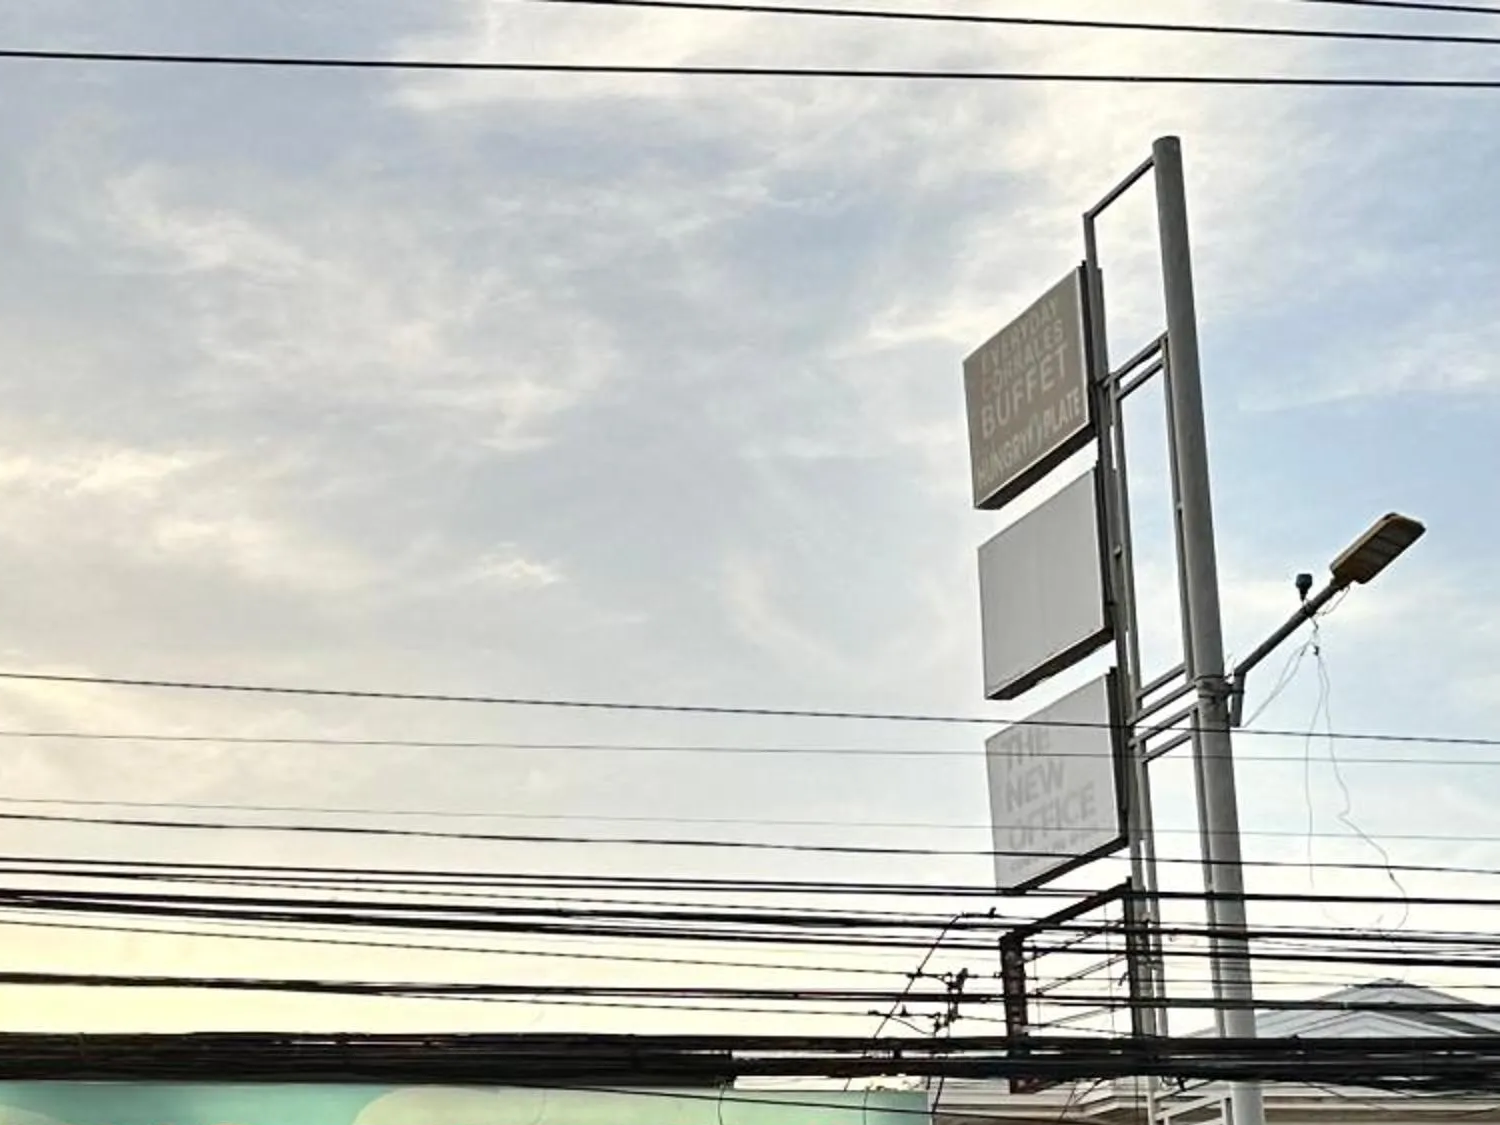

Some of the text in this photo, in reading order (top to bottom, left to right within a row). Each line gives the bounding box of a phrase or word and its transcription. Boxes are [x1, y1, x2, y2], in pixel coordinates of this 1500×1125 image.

[981, 299, 1057, 375] EVERYDAY
[981, 319, 1064, 400] CORRALES
[980, 342, 1068, 440] BUFFET
[1042, 387, 1081, 434] PLATE
[1005, 757, 1065, 813] NEW
[1009, 781, 1096, 850] OFFICE
